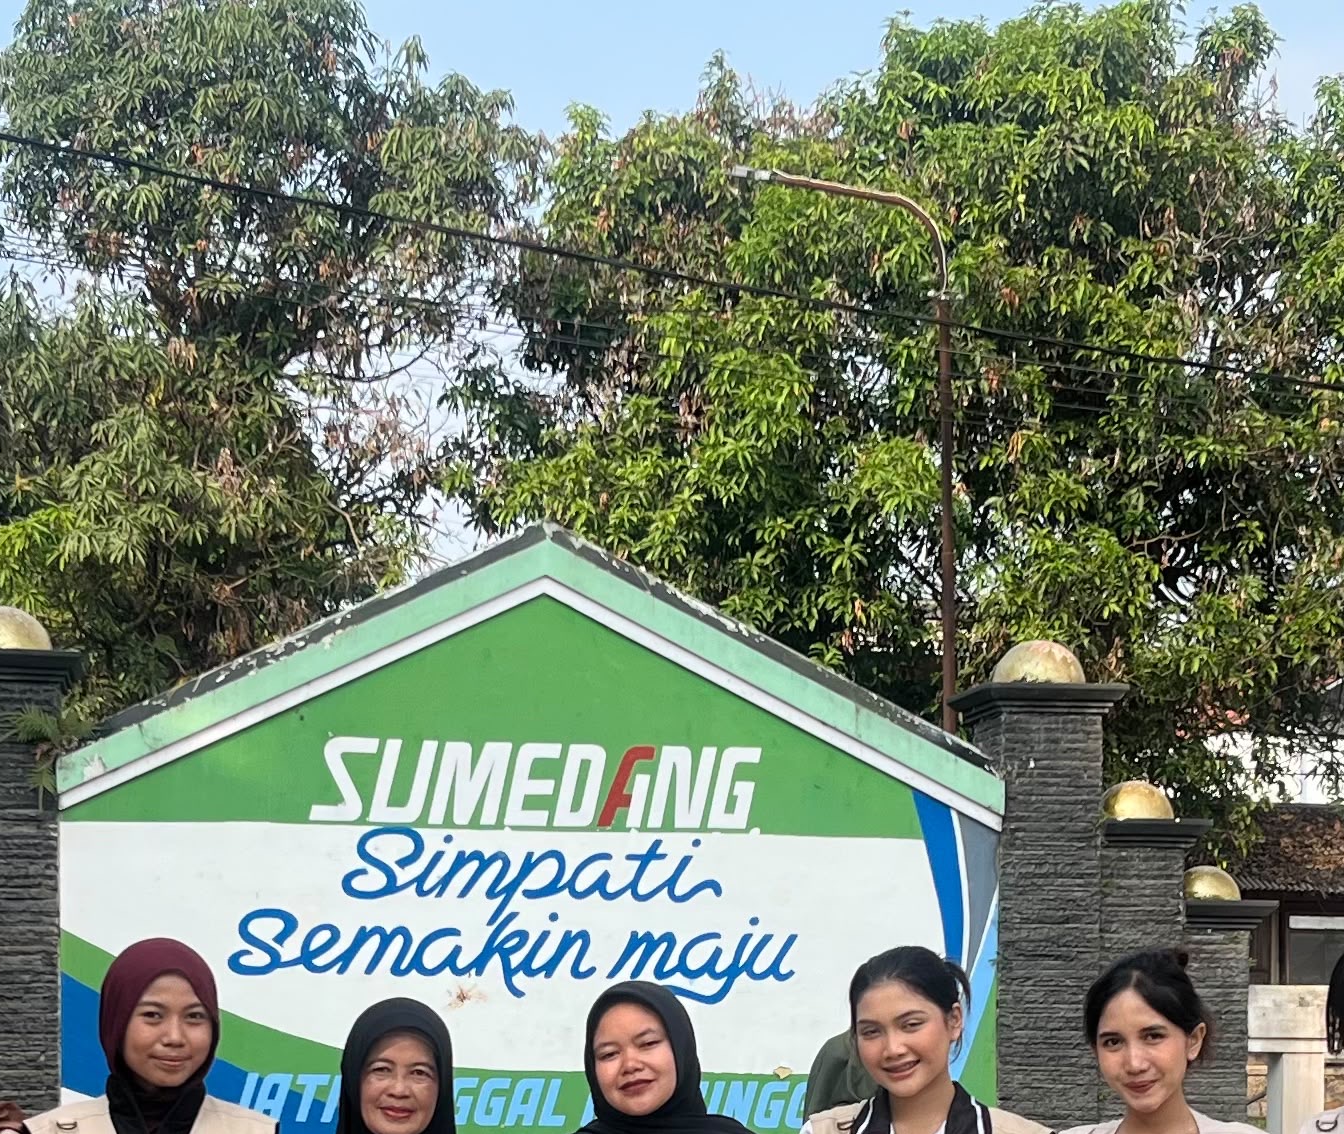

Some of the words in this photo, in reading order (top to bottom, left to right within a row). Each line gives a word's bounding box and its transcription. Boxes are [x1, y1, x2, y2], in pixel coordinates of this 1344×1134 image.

[309, 737, 762, 829] SUMEDANG
[341, 826, 722, 926] Simpati
[228, 908, 596, 999] Semakin
[606, 916, 798, 1005] maju
